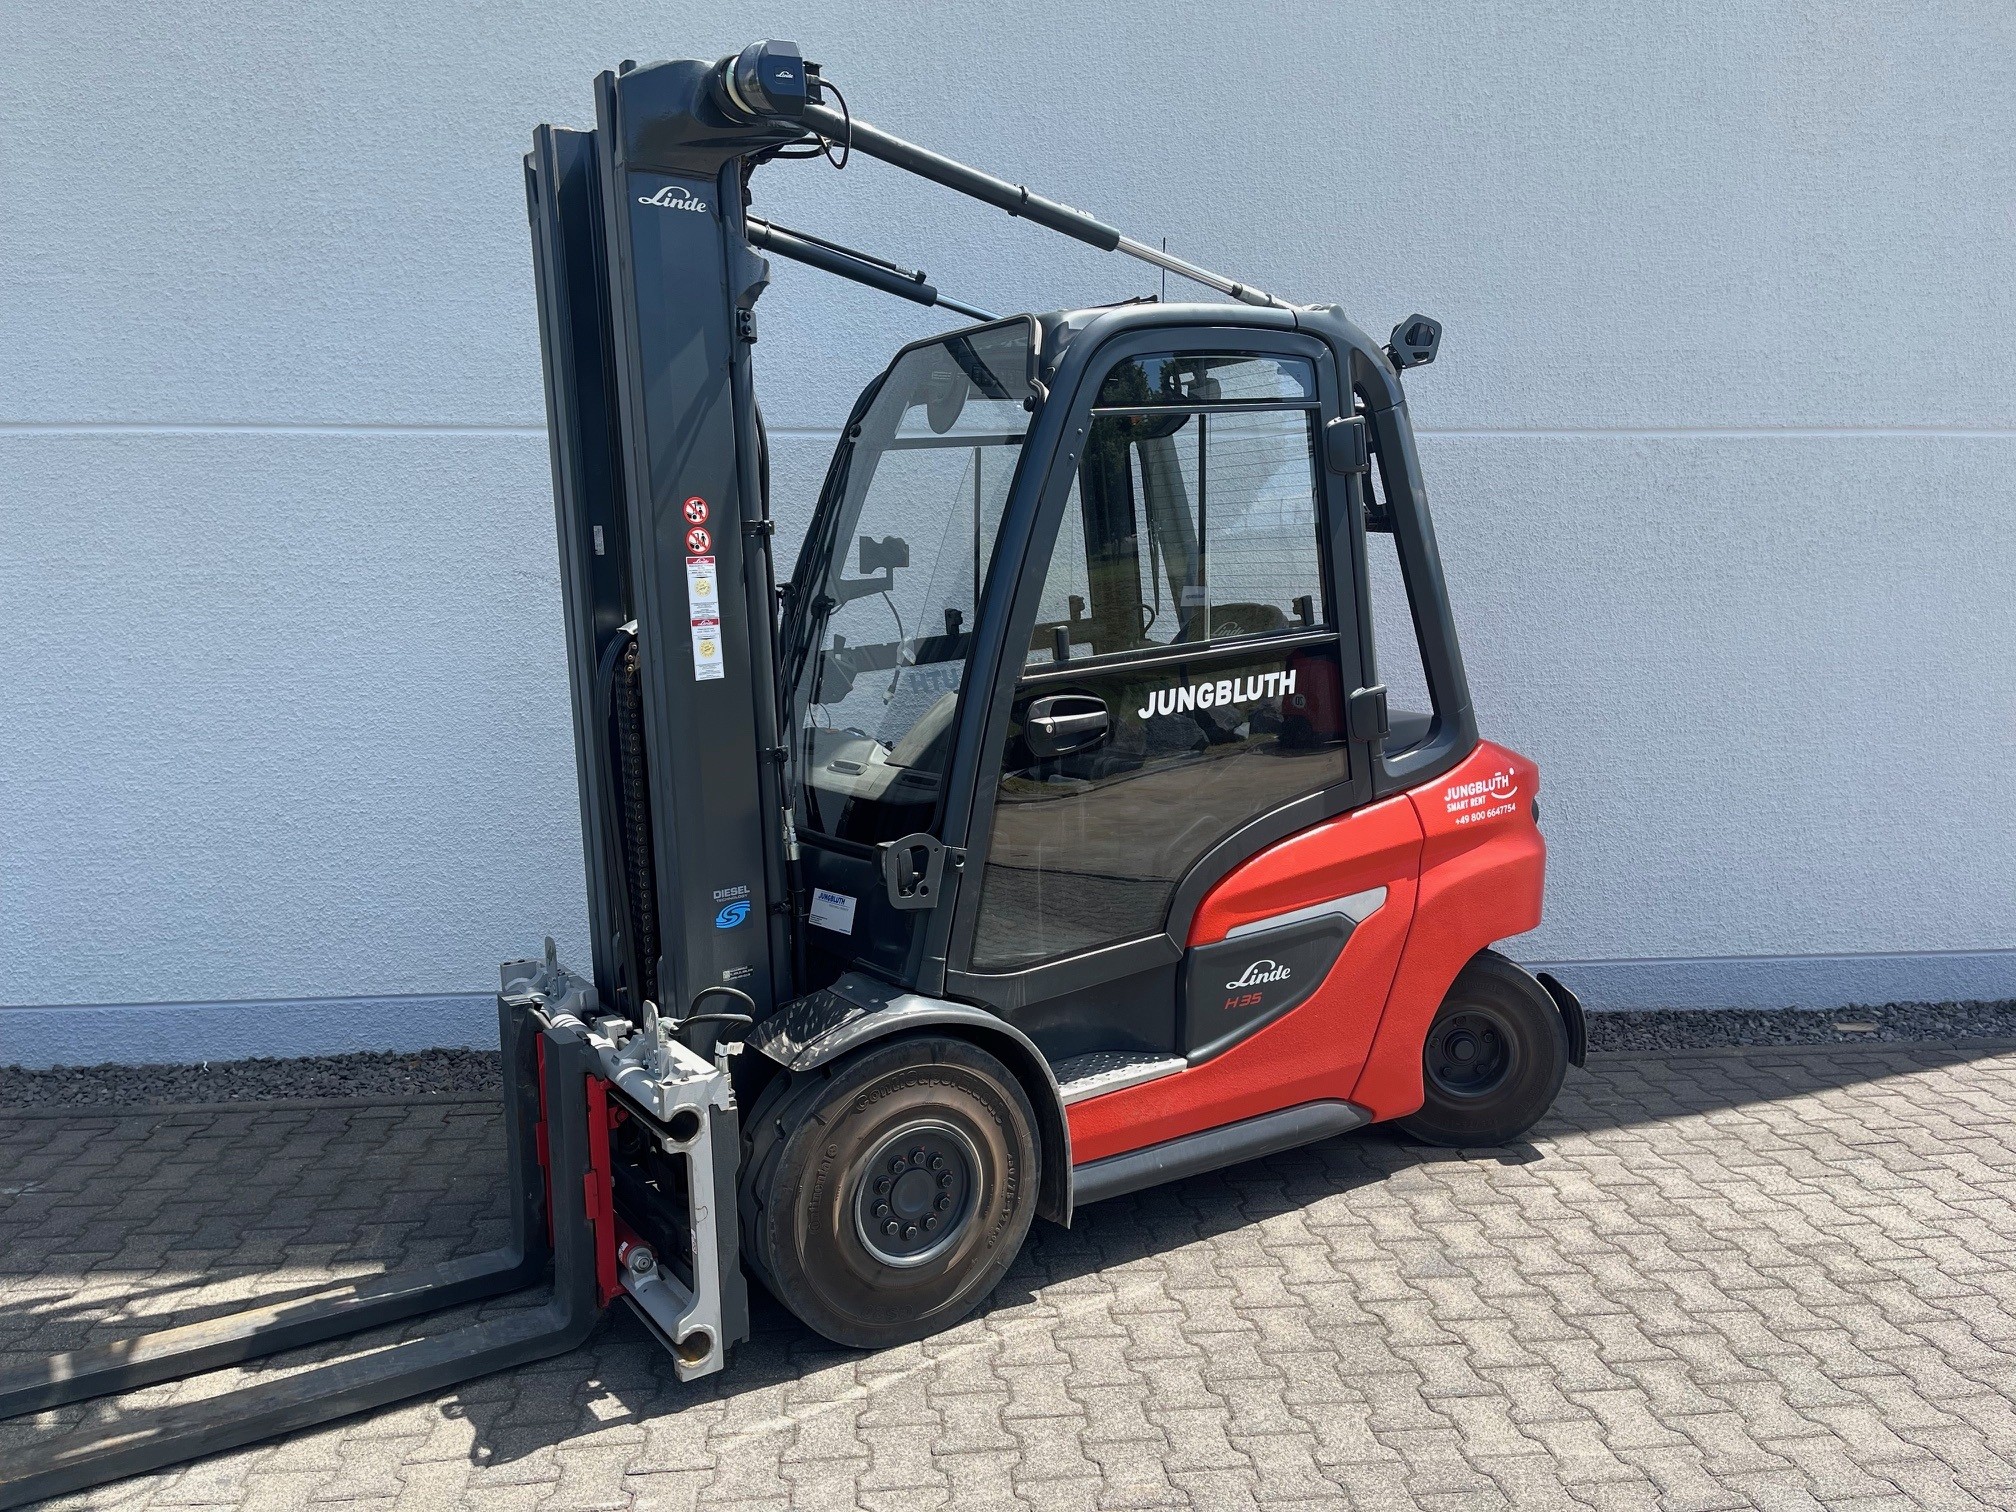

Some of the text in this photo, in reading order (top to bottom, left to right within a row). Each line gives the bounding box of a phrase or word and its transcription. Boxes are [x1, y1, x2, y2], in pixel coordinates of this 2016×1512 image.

[637, 185, 707, 213] Linde
[1137, 669, 1297, 719] JUNGBLUTH
[1444, 774, 1510, 801] JUNGBLUTH
[1446, 795, 1487, 813] SMART RENT
[1455, 802, 1516, 826] +49 800 6647754
[713, 885, 751, 900] DIESEL
[1225, 959, 1291, 990] Linde
